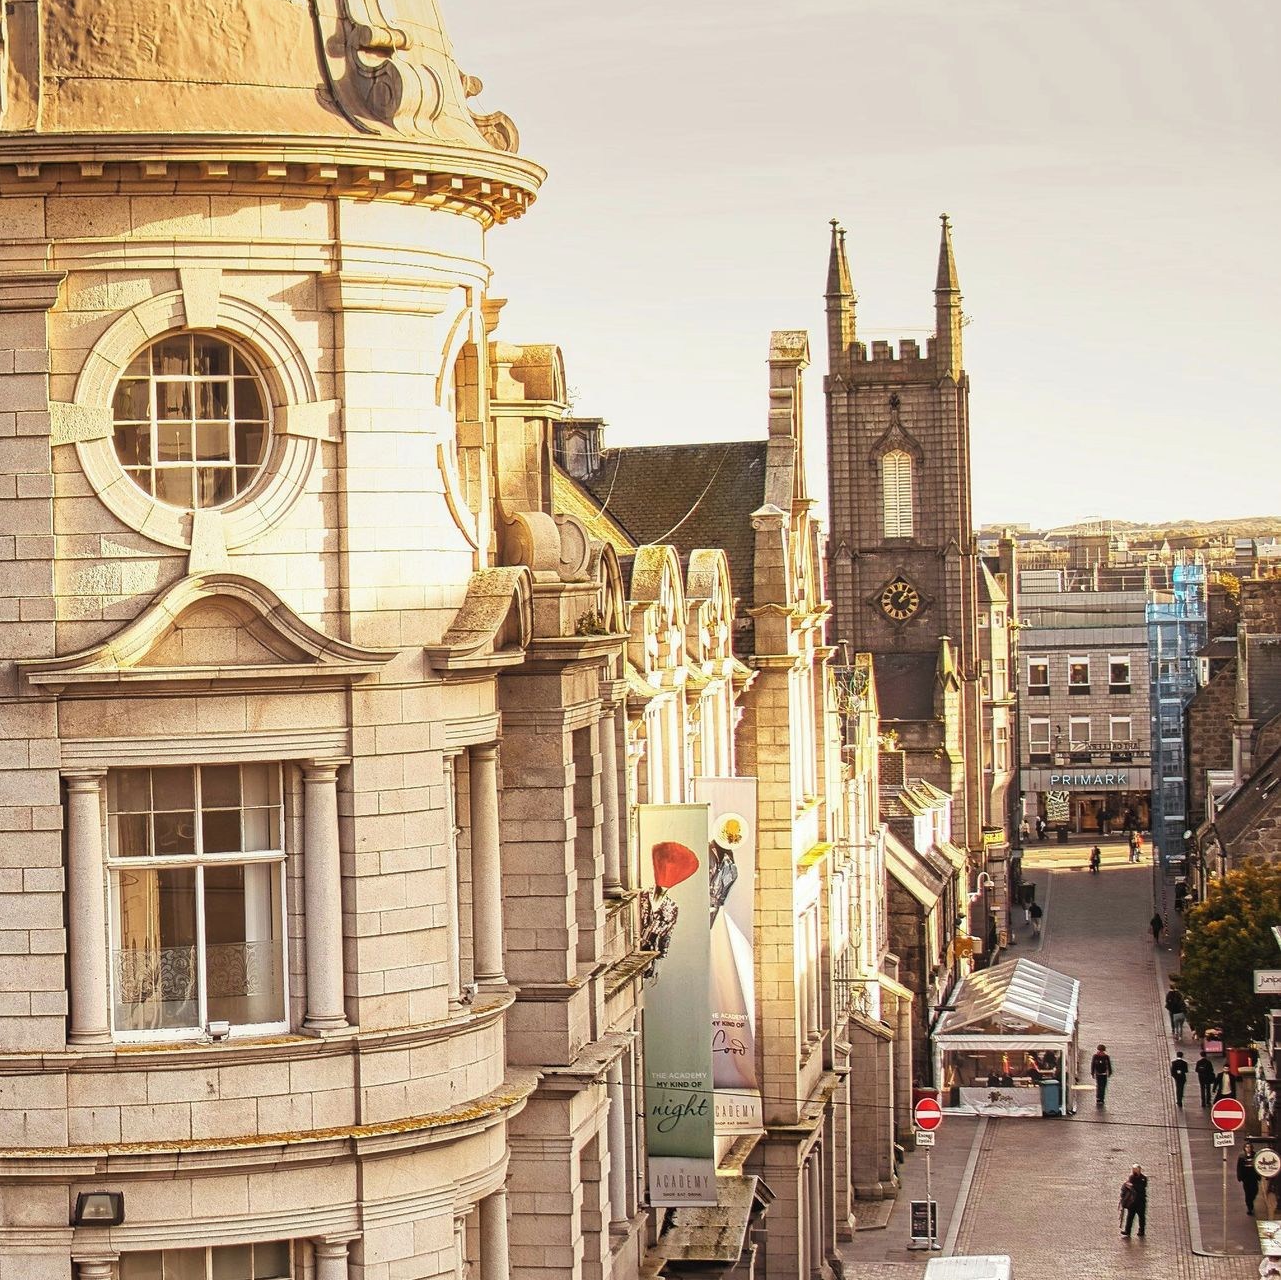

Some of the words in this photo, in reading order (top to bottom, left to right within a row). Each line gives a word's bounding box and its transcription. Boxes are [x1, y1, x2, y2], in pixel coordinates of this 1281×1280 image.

[1050, 774, 1127, 785] PRIMARK
[651, 1072, 667, 1080] THE
[668, 1072, 708, 1080] ACADEMY
[652, 1093, 710, 1133] night
[715, 1105, 756, 1118] CADEMY
[656, 1175, 709, 1188] ACADEMY
